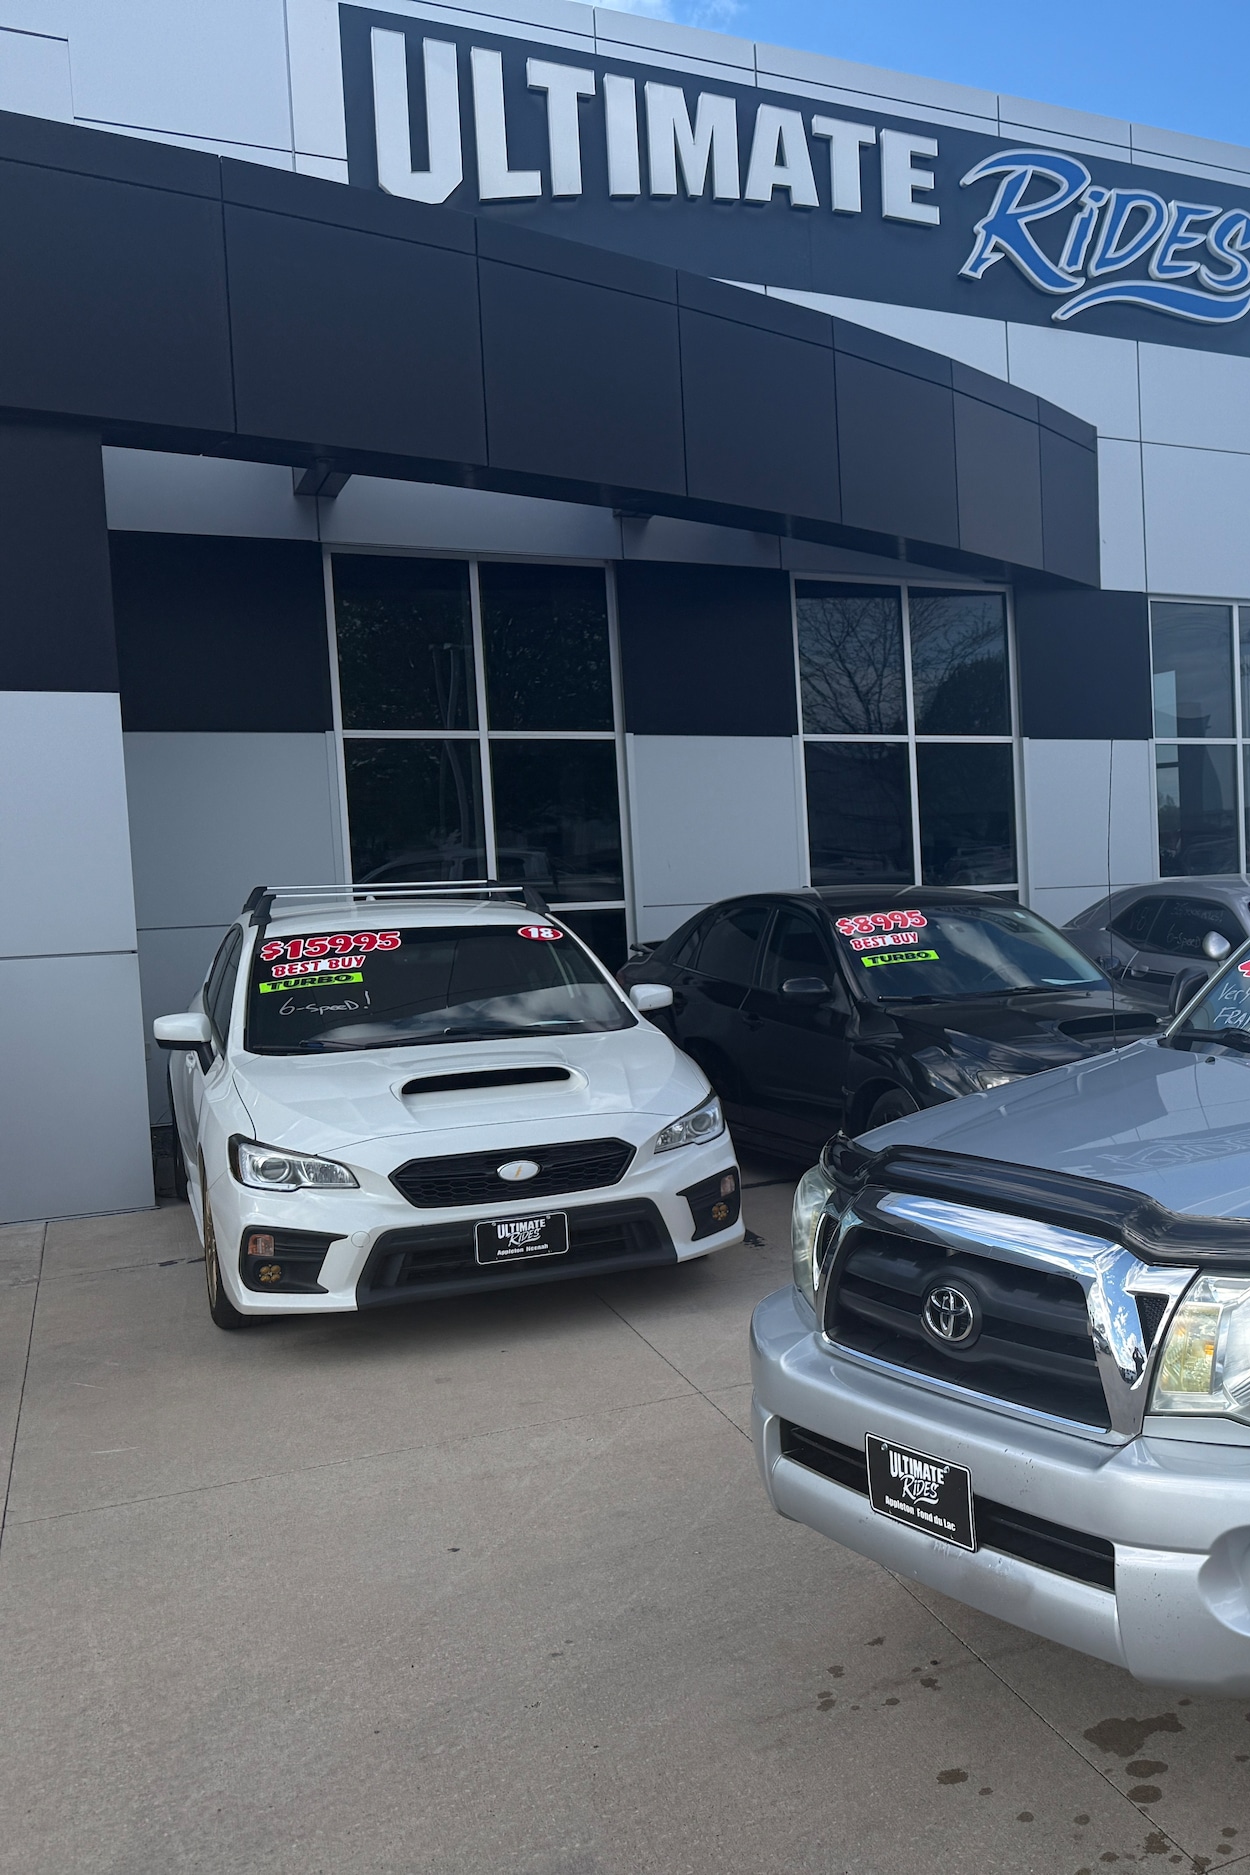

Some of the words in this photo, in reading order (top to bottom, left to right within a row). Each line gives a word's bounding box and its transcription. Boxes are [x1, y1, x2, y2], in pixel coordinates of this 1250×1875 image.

[369, 26, 940, 226] ULTIMATE
[527, 927, 554, 938] 18
[836, 910, 927, 936] $8995
[260, 931, 401, 961] $15995
[850, 935, 888, 951] BEST
[890, 932, 918, 945] BUY
[271, 959, 322, 978] BEST
[327, 955, 366, 971] BUY
[867, 952, 932, 964] TURBO
[266, 974, 353, 990] TURBO
[497, 1219, 546, 1239] ULTIMATE
[497, 1247, 524, 1256] Appleton
[889, 1450, 945, 1485] ULTIMATE
[885, 1495, 915, 1515] Appleton
[916, 1507, 933, 1522] Fond
[933, 1513, 943, 1527] du
[943, 1518, 956, 1532] Lac
